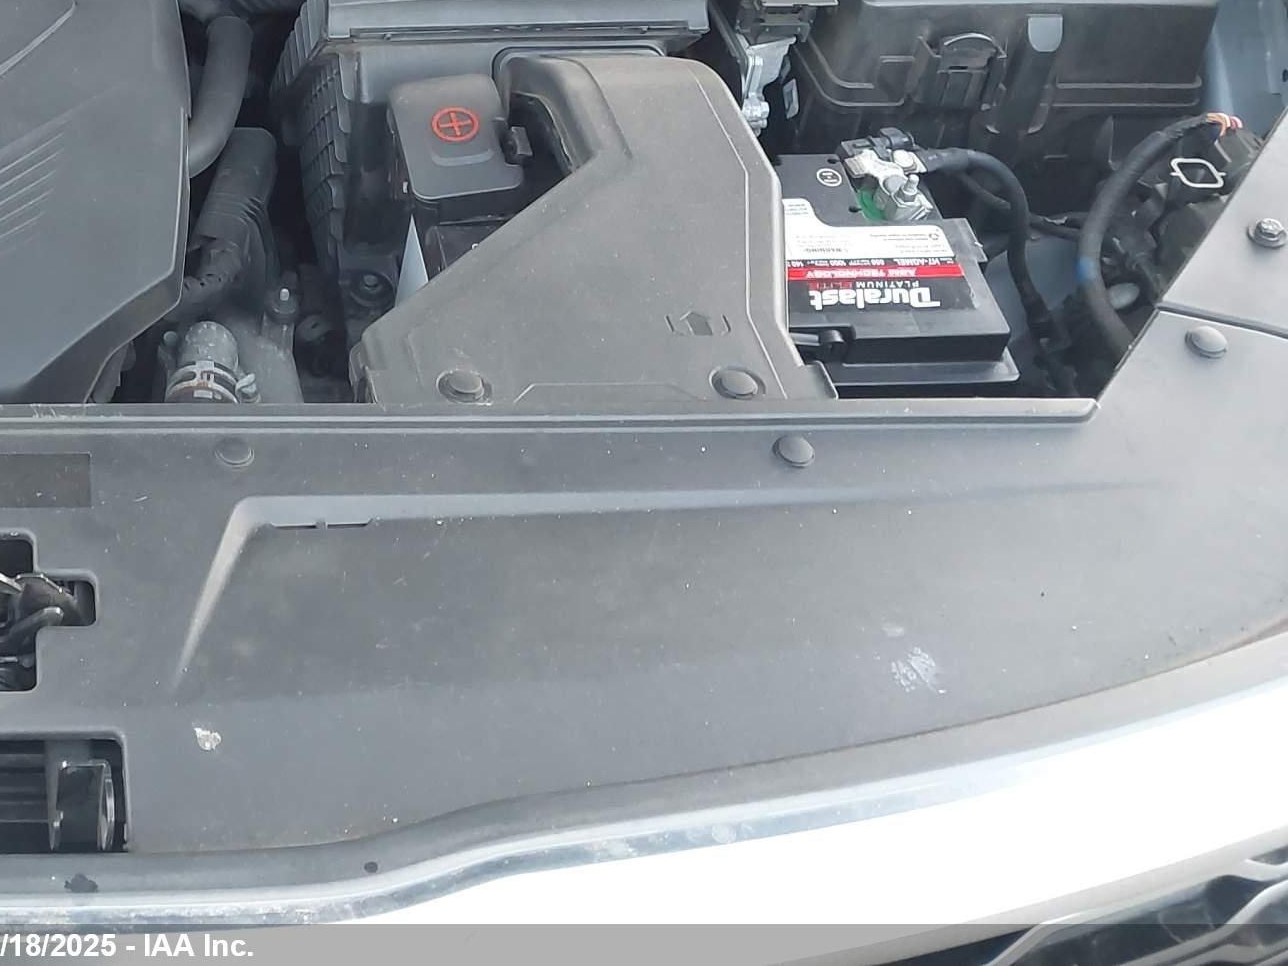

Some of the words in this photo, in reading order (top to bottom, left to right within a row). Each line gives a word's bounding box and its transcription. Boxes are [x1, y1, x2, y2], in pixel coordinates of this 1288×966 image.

[805, 269, 885, 279] TECHNOLOGY
[855, 280, 919, 288] PLATINUM
[808, 287, 941, 311] Duralast
